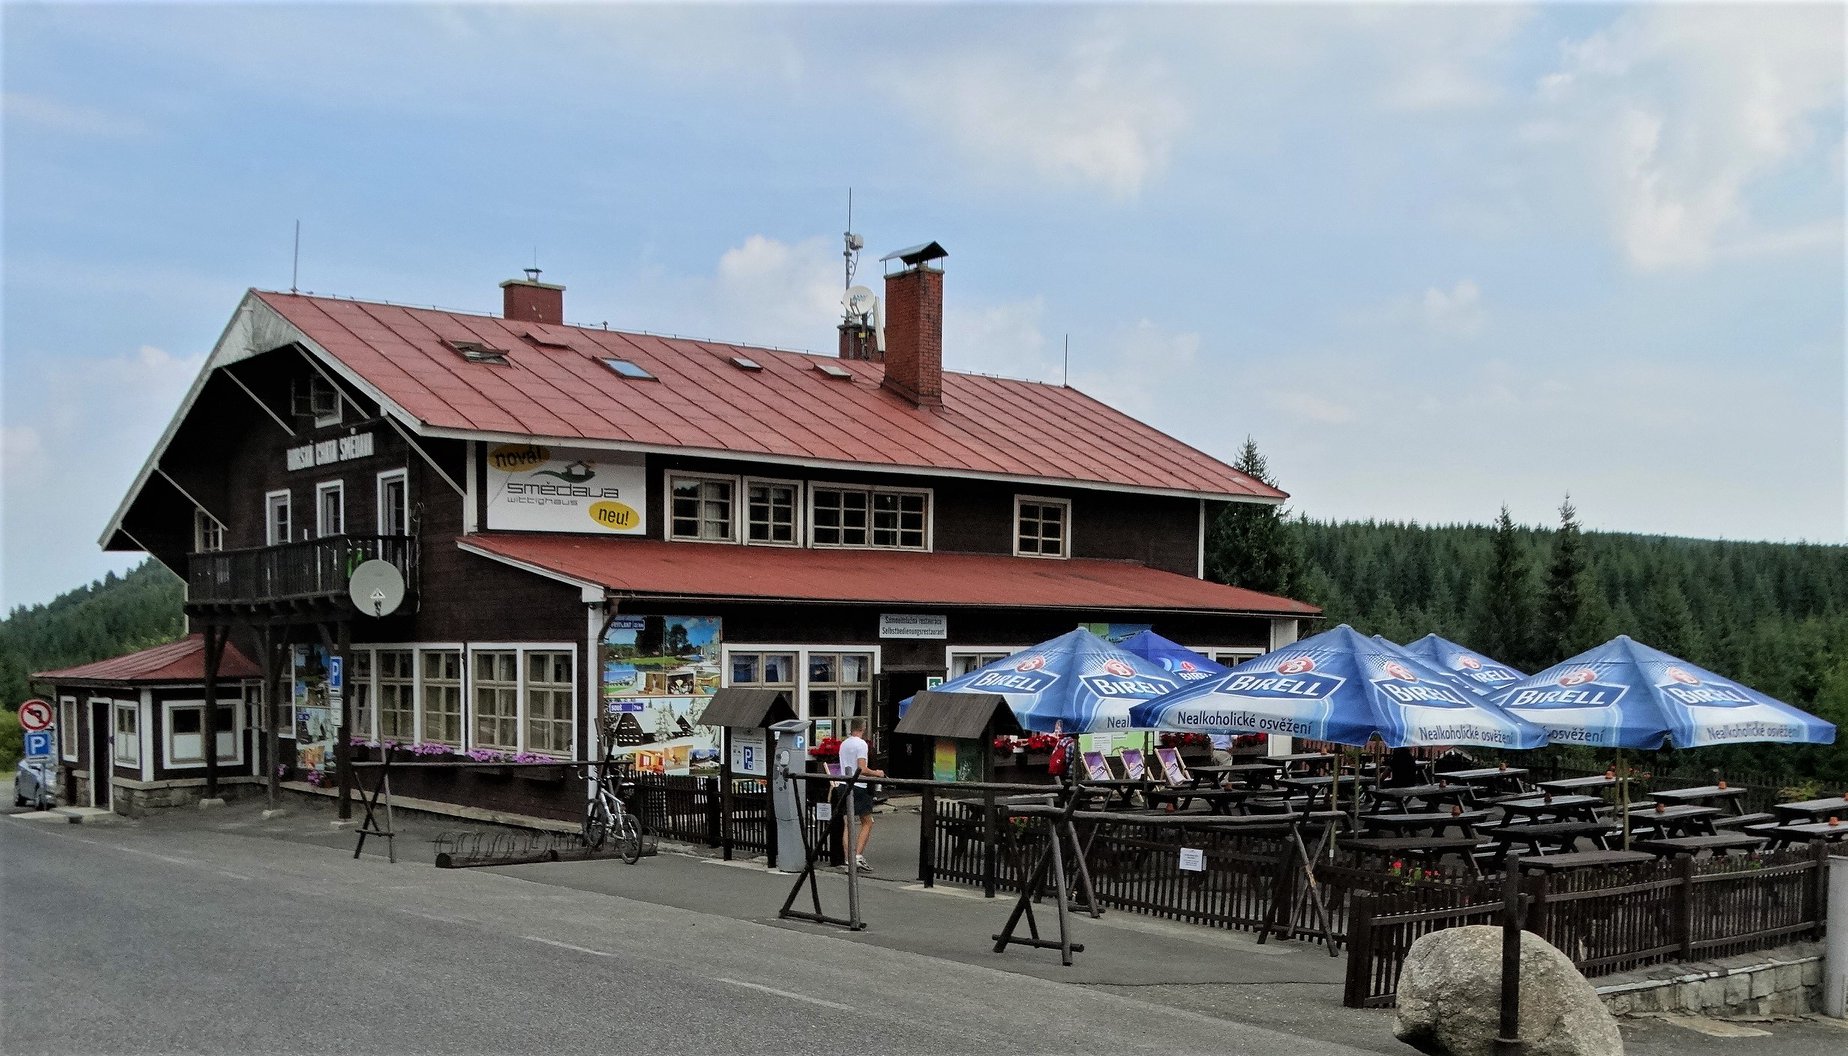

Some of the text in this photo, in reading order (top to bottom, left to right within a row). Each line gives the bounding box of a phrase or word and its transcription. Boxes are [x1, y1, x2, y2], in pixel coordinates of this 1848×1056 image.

[507, 497, 578, 506] wittighaus
[598, 508, 629, 526] neu!
[332, 661, 340, 685] P
[974, 673, 1042, 691] BIRELL
[1464, 669, 1516, 683] IRELL
[1225, 675, 1322, 696] BIRELL
[1383, 684, 1467, 704] BIRELL
[1511, 689, 1605, 705] BIRELL
[1668, 688, 1750, 703] BIRELL
[1178, 711, 1313, 735] Nealkoholické osvěžení
[1707, 721, 1801, 740] Nealkoholické osvěžení
[1419, 724, 1513, 745] Nealkoholické osvěžení
[1551, 727, 1606, 743] osvěžení
[30, 736, 46, 755] P
[744, 748, 752, 763] P
